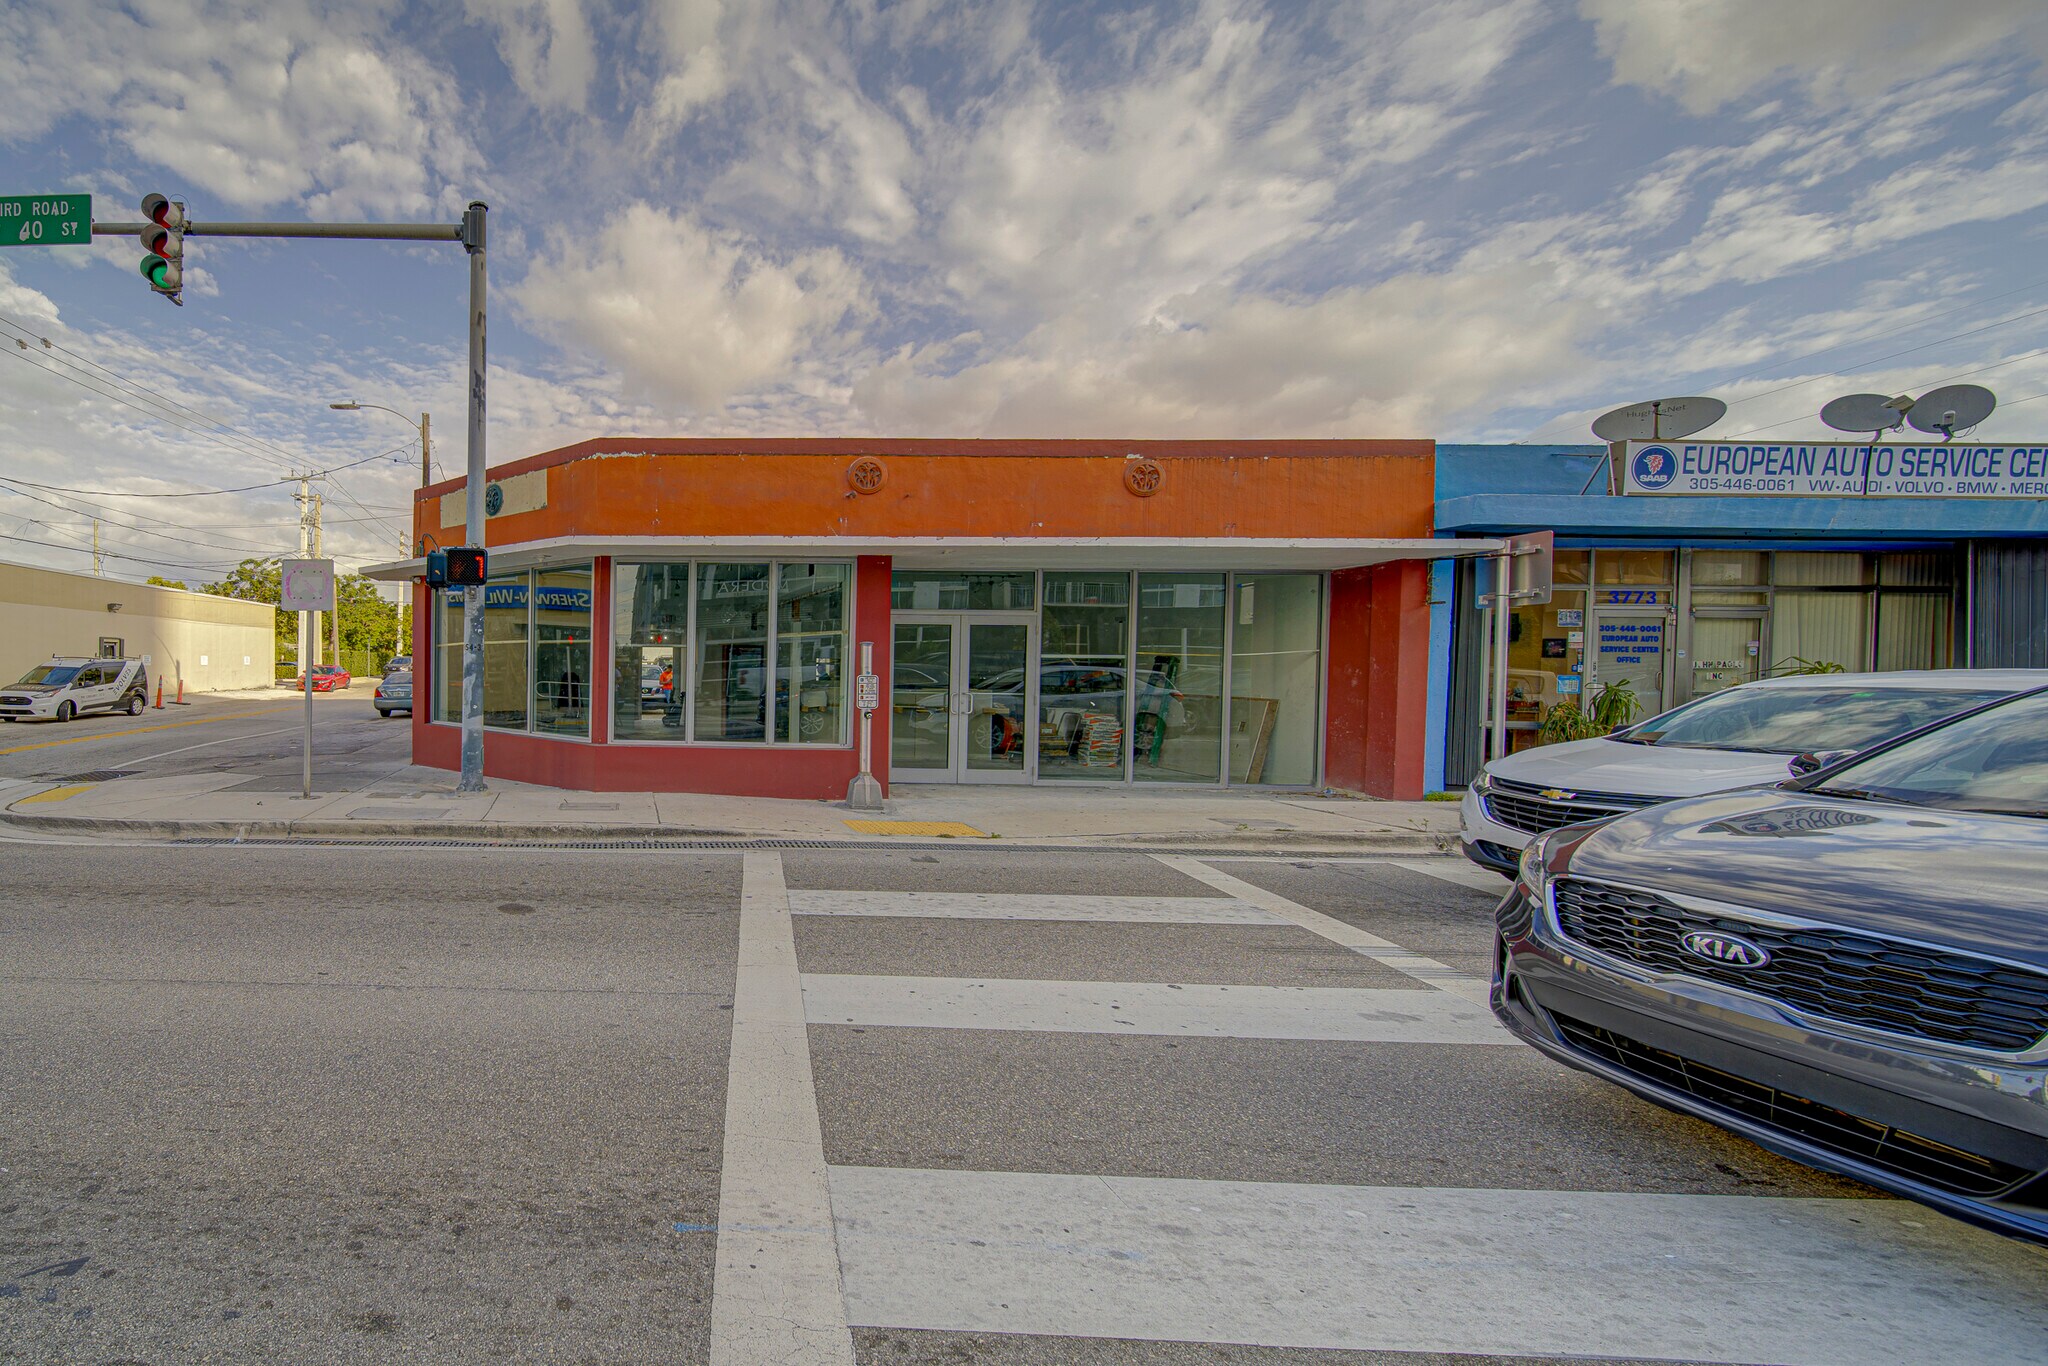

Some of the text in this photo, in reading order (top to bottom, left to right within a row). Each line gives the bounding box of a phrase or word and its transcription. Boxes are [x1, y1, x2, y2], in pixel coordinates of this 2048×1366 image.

[32, 201, 69, 216] ROAD
[19, 220, 78, 241] 40 ST
[1625, 404, 1687, 419] HughsNet
[1682, 446, 1817, 476] EUROPEAN
[1820, 447, 1894, 477] AUTO
[1899, 448, 2005, 478] SERVICE
[1639, 474, 1668, 482] SAAB
[1689, 478, 1795, 491] 305-446-0061
[1894, 481, 1944, 494] VOLVO
[1956, 482, 1999, 494] BMW
[1608, 590, 1657, 604] 3773
[1692, 936, 1751, 965] KIA
